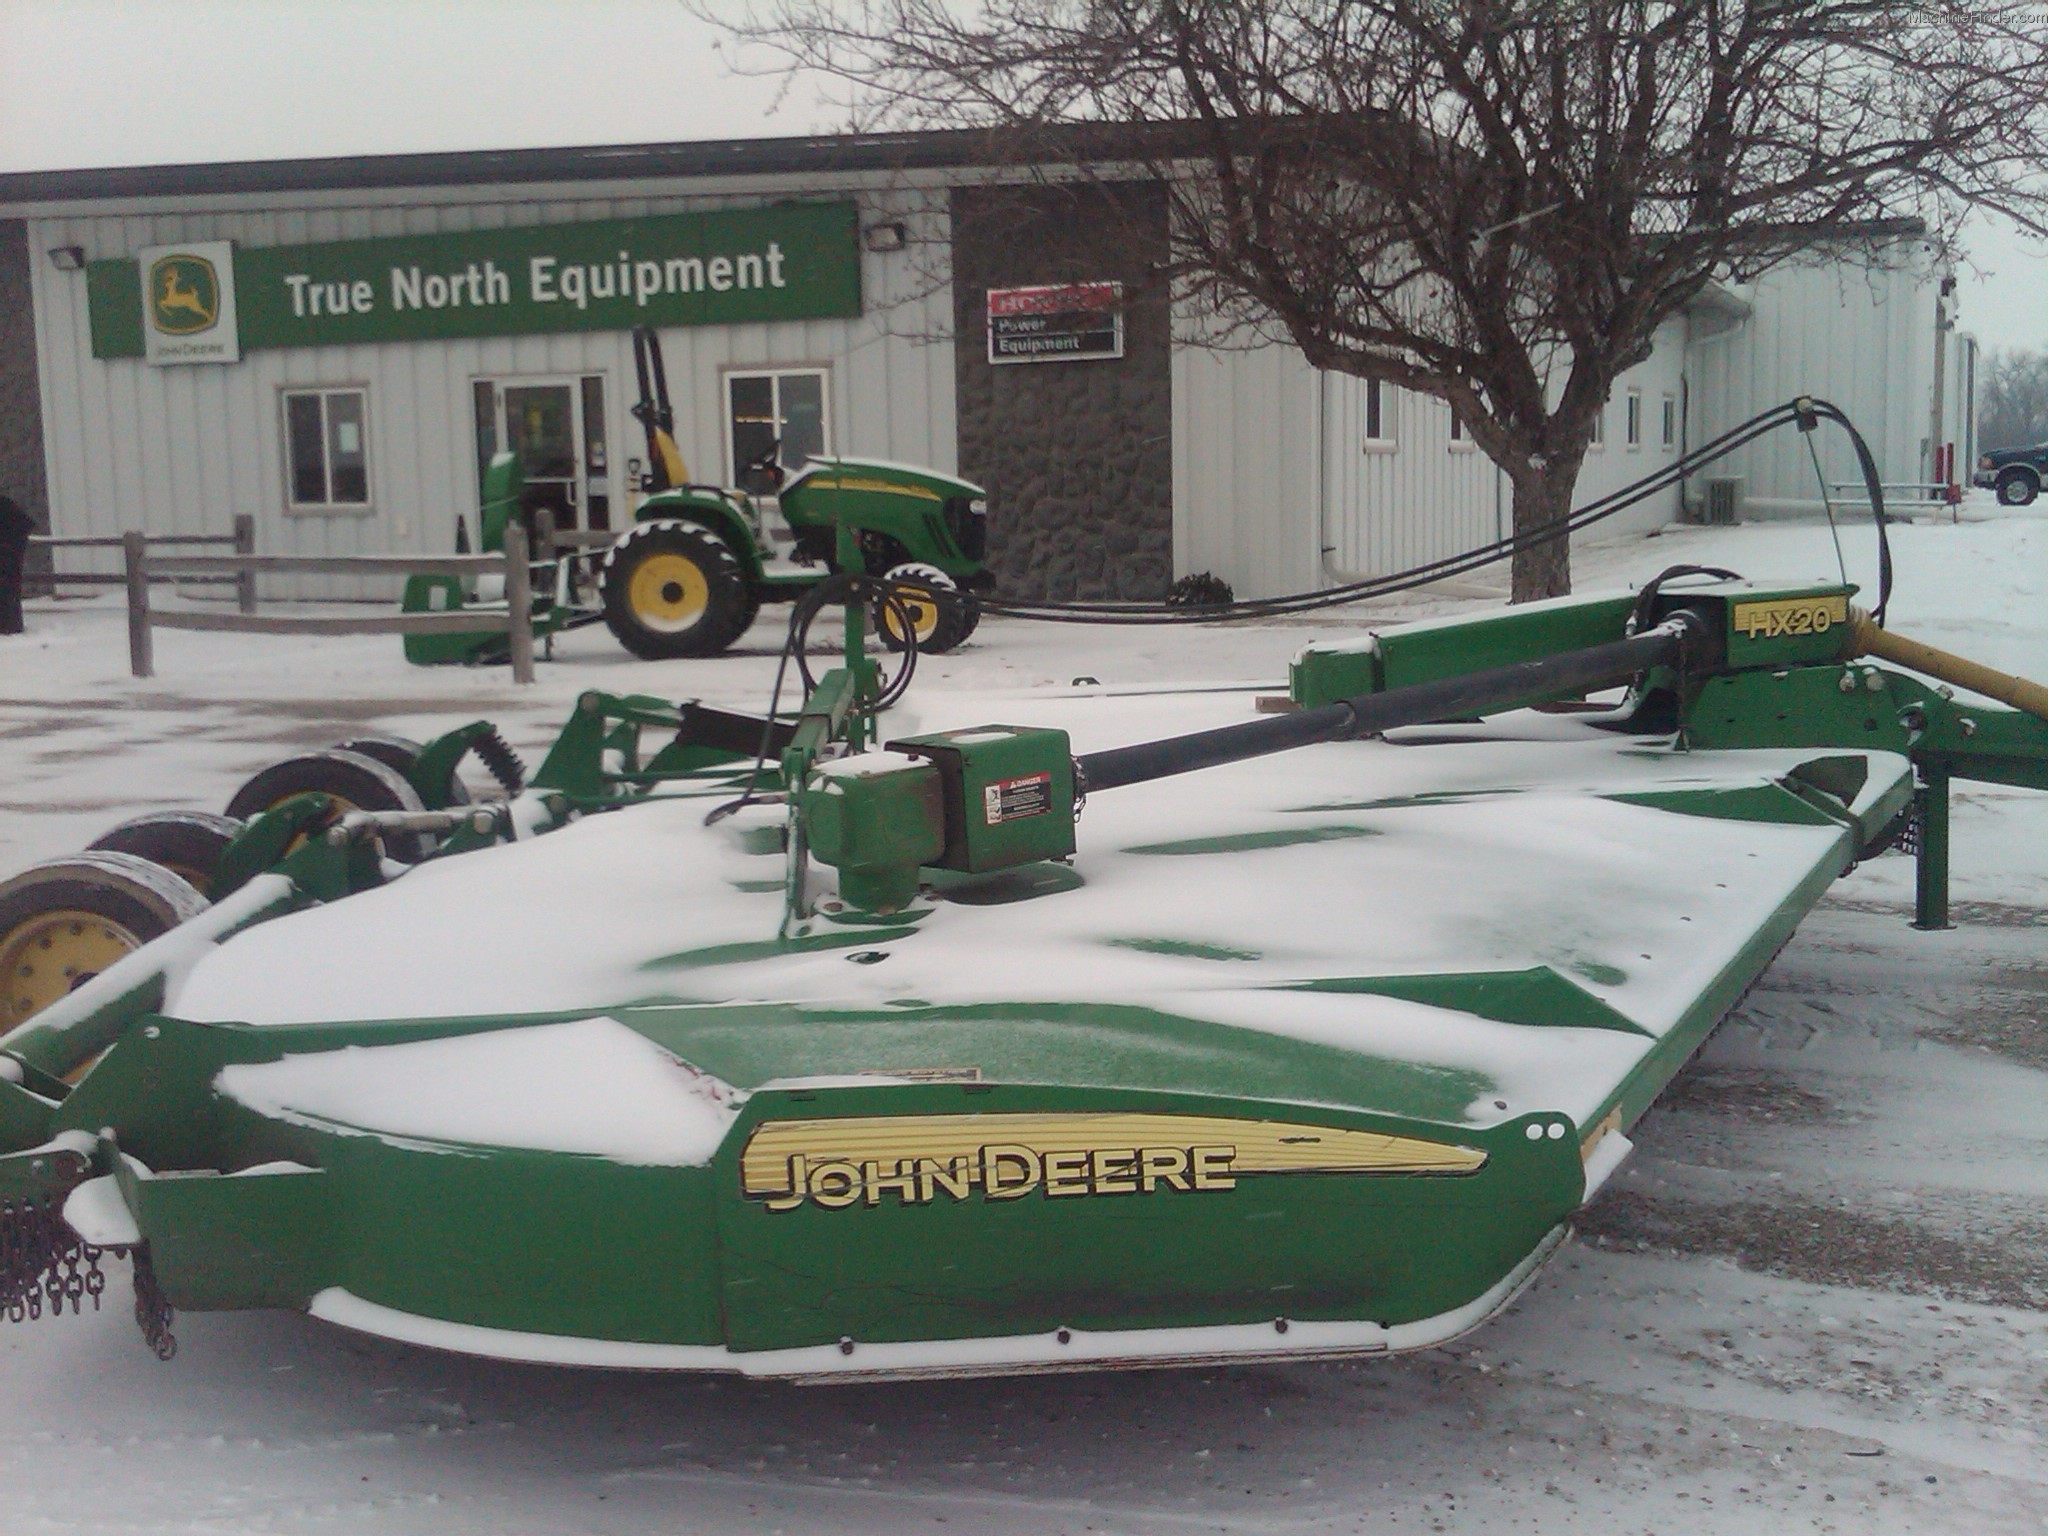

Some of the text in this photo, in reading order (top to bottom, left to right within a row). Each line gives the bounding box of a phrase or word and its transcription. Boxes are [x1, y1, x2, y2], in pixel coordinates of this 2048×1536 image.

[284, 241, 786, 318] True North Equipment
[1000, 335, 1080, 355] Equipment
[1750, 605, 1832, 640] HX20
[764, 1142, 1236, 1215] JOHN DEERE
